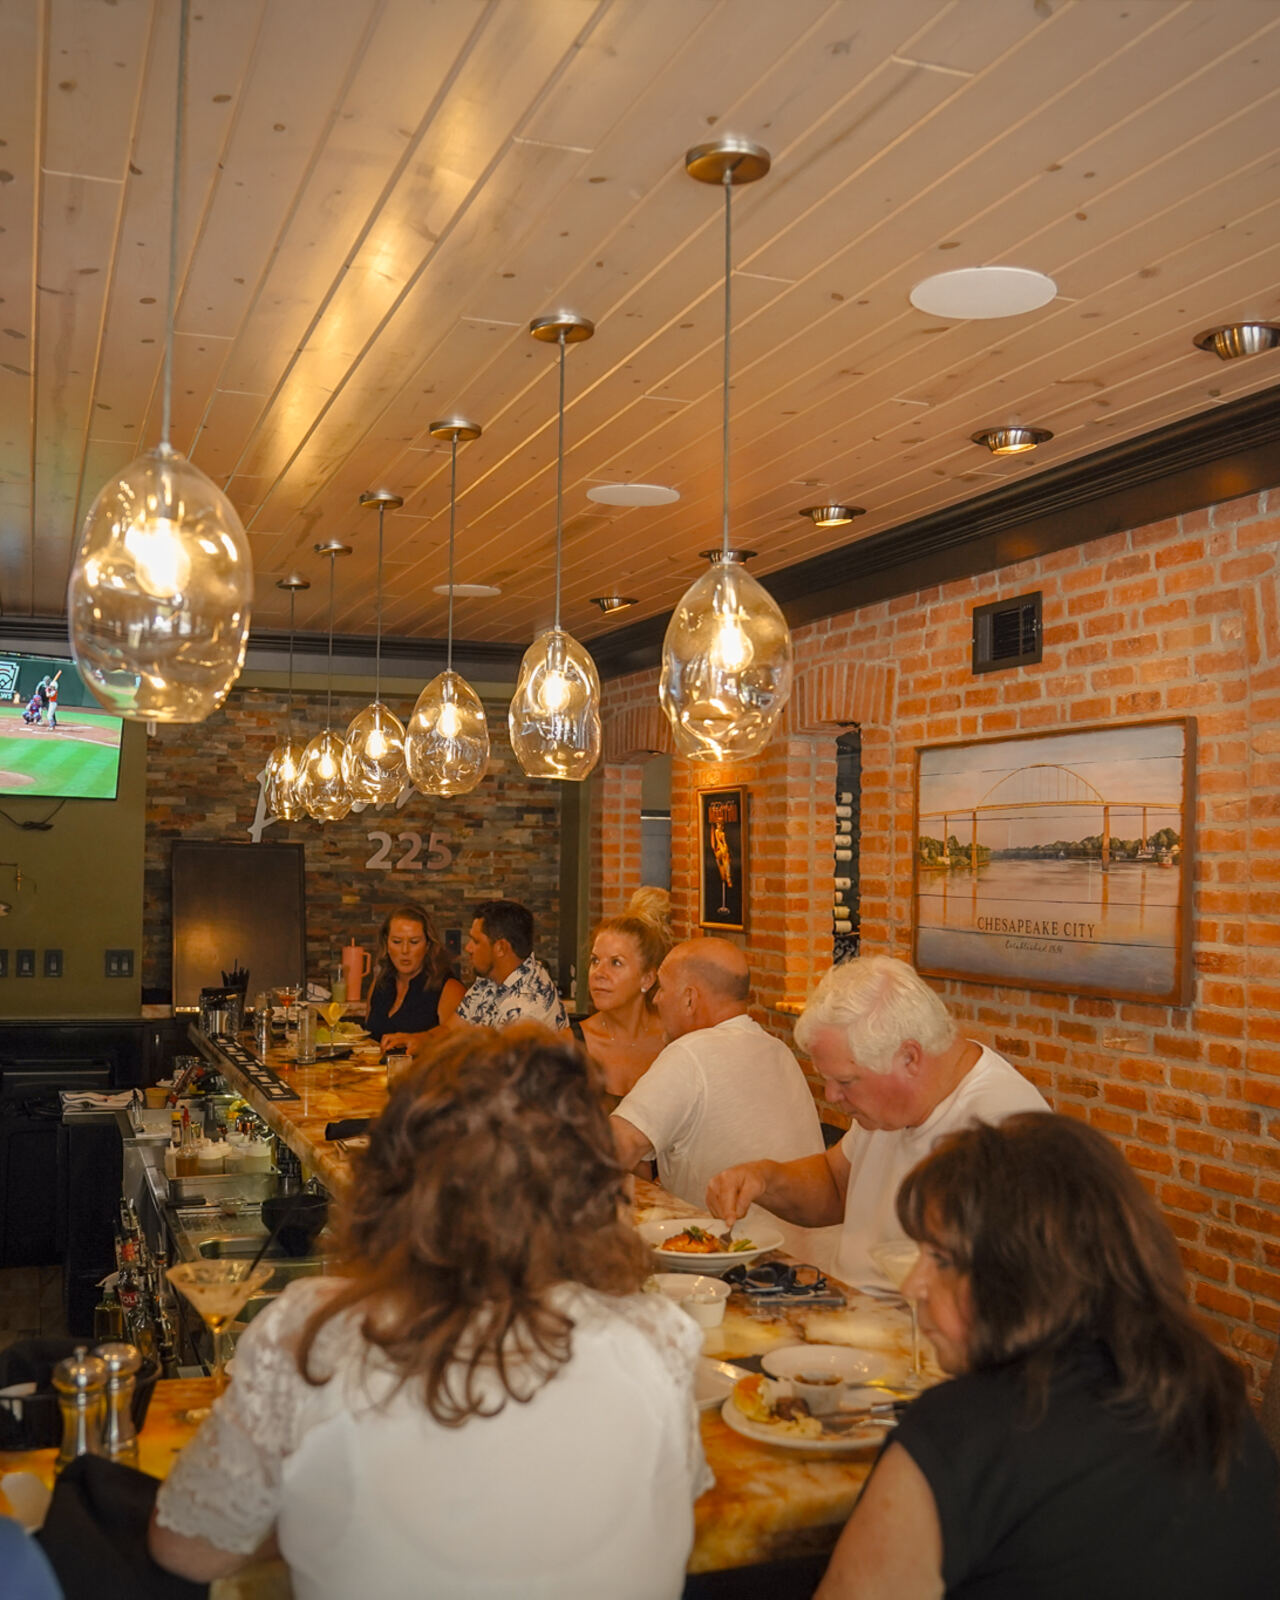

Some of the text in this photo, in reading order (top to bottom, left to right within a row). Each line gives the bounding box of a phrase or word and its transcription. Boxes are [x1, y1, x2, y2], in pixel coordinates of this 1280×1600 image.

[365, 831, 453, 870] 225
[977, 916, 1096, 938] CHESAPEAKE CITY
